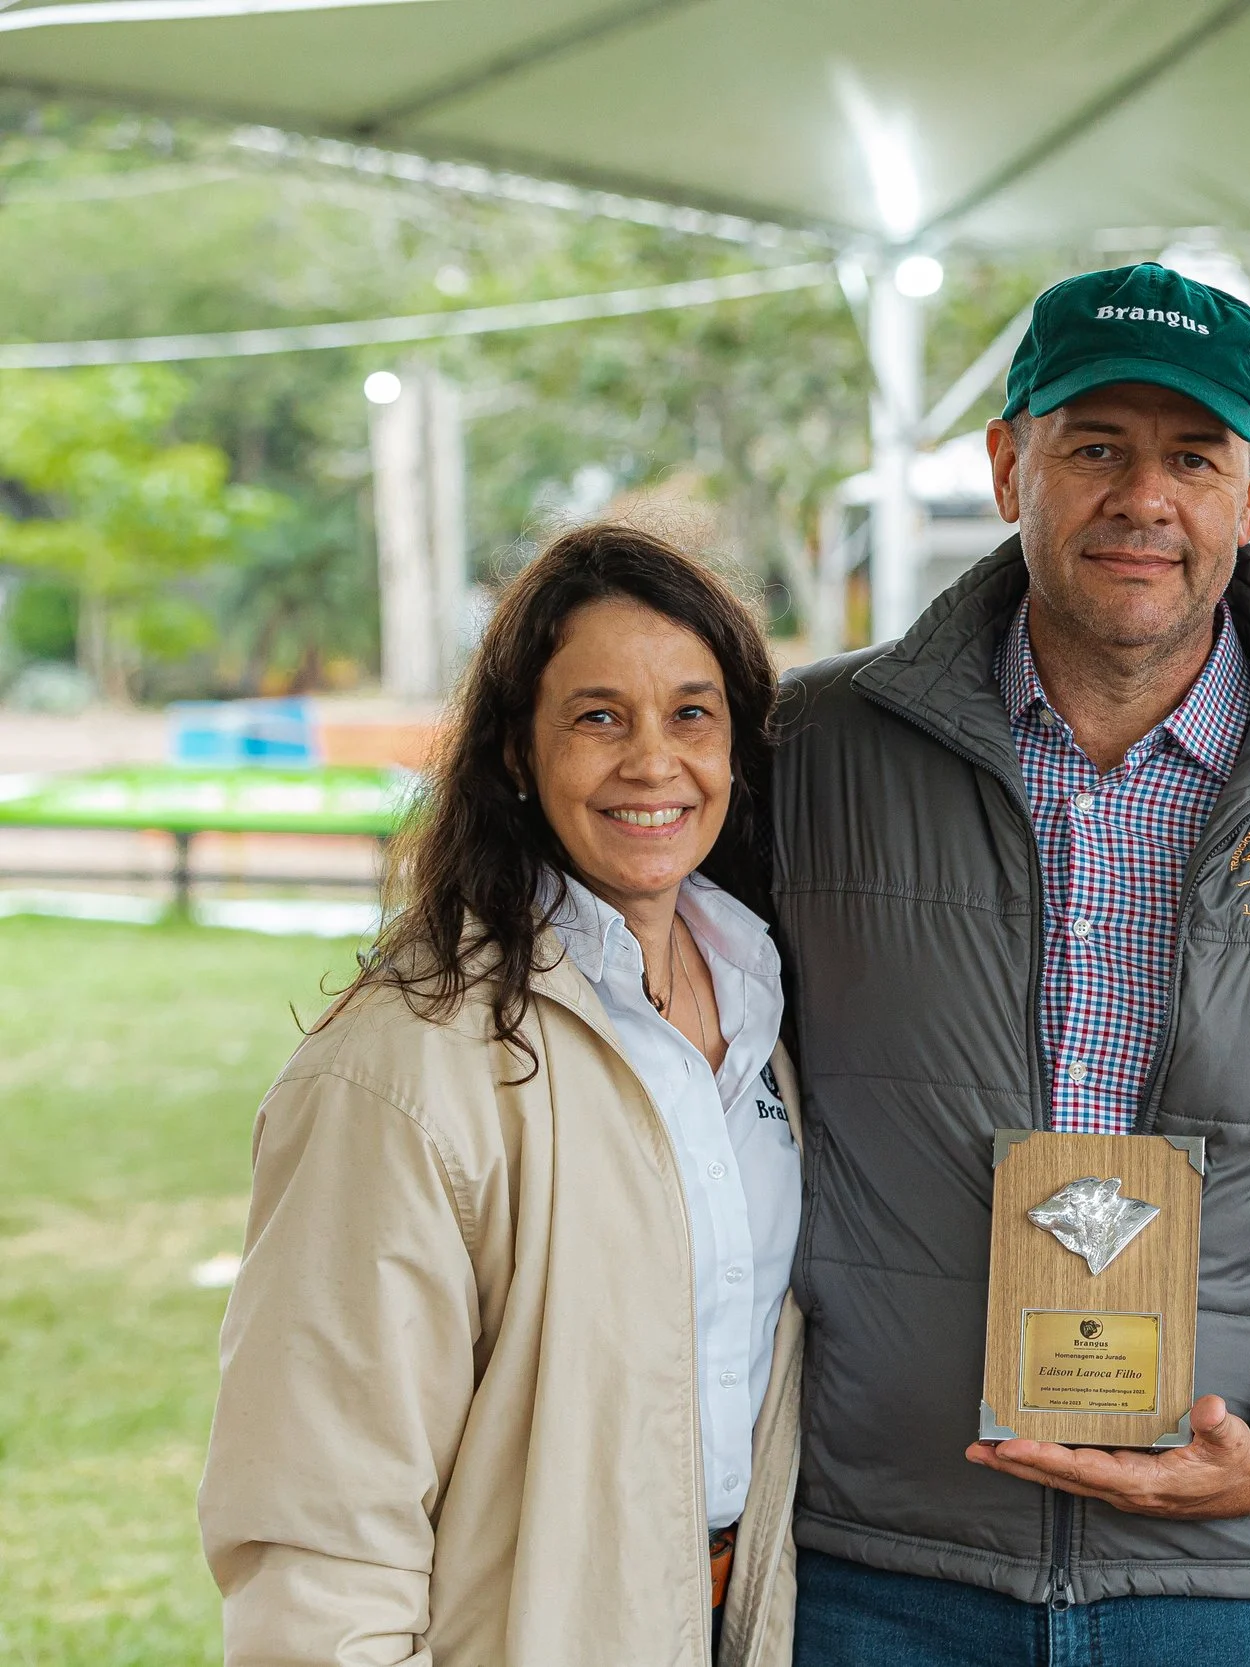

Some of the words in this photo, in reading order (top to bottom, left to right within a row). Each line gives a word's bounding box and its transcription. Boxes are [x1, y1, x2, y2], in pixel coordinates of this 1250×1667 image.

[1094, 305, 1210, 335] Brangus
[1074, 1339, 1108, 1347] Brangus
[1054, 1352, 1095, 1361] Homenagem
[1038, 1366, 1074, 1377] Edison
[1076, 1368, 1112, 1379] Laroca
[1115, 1369, 1142, 1379] Filho
